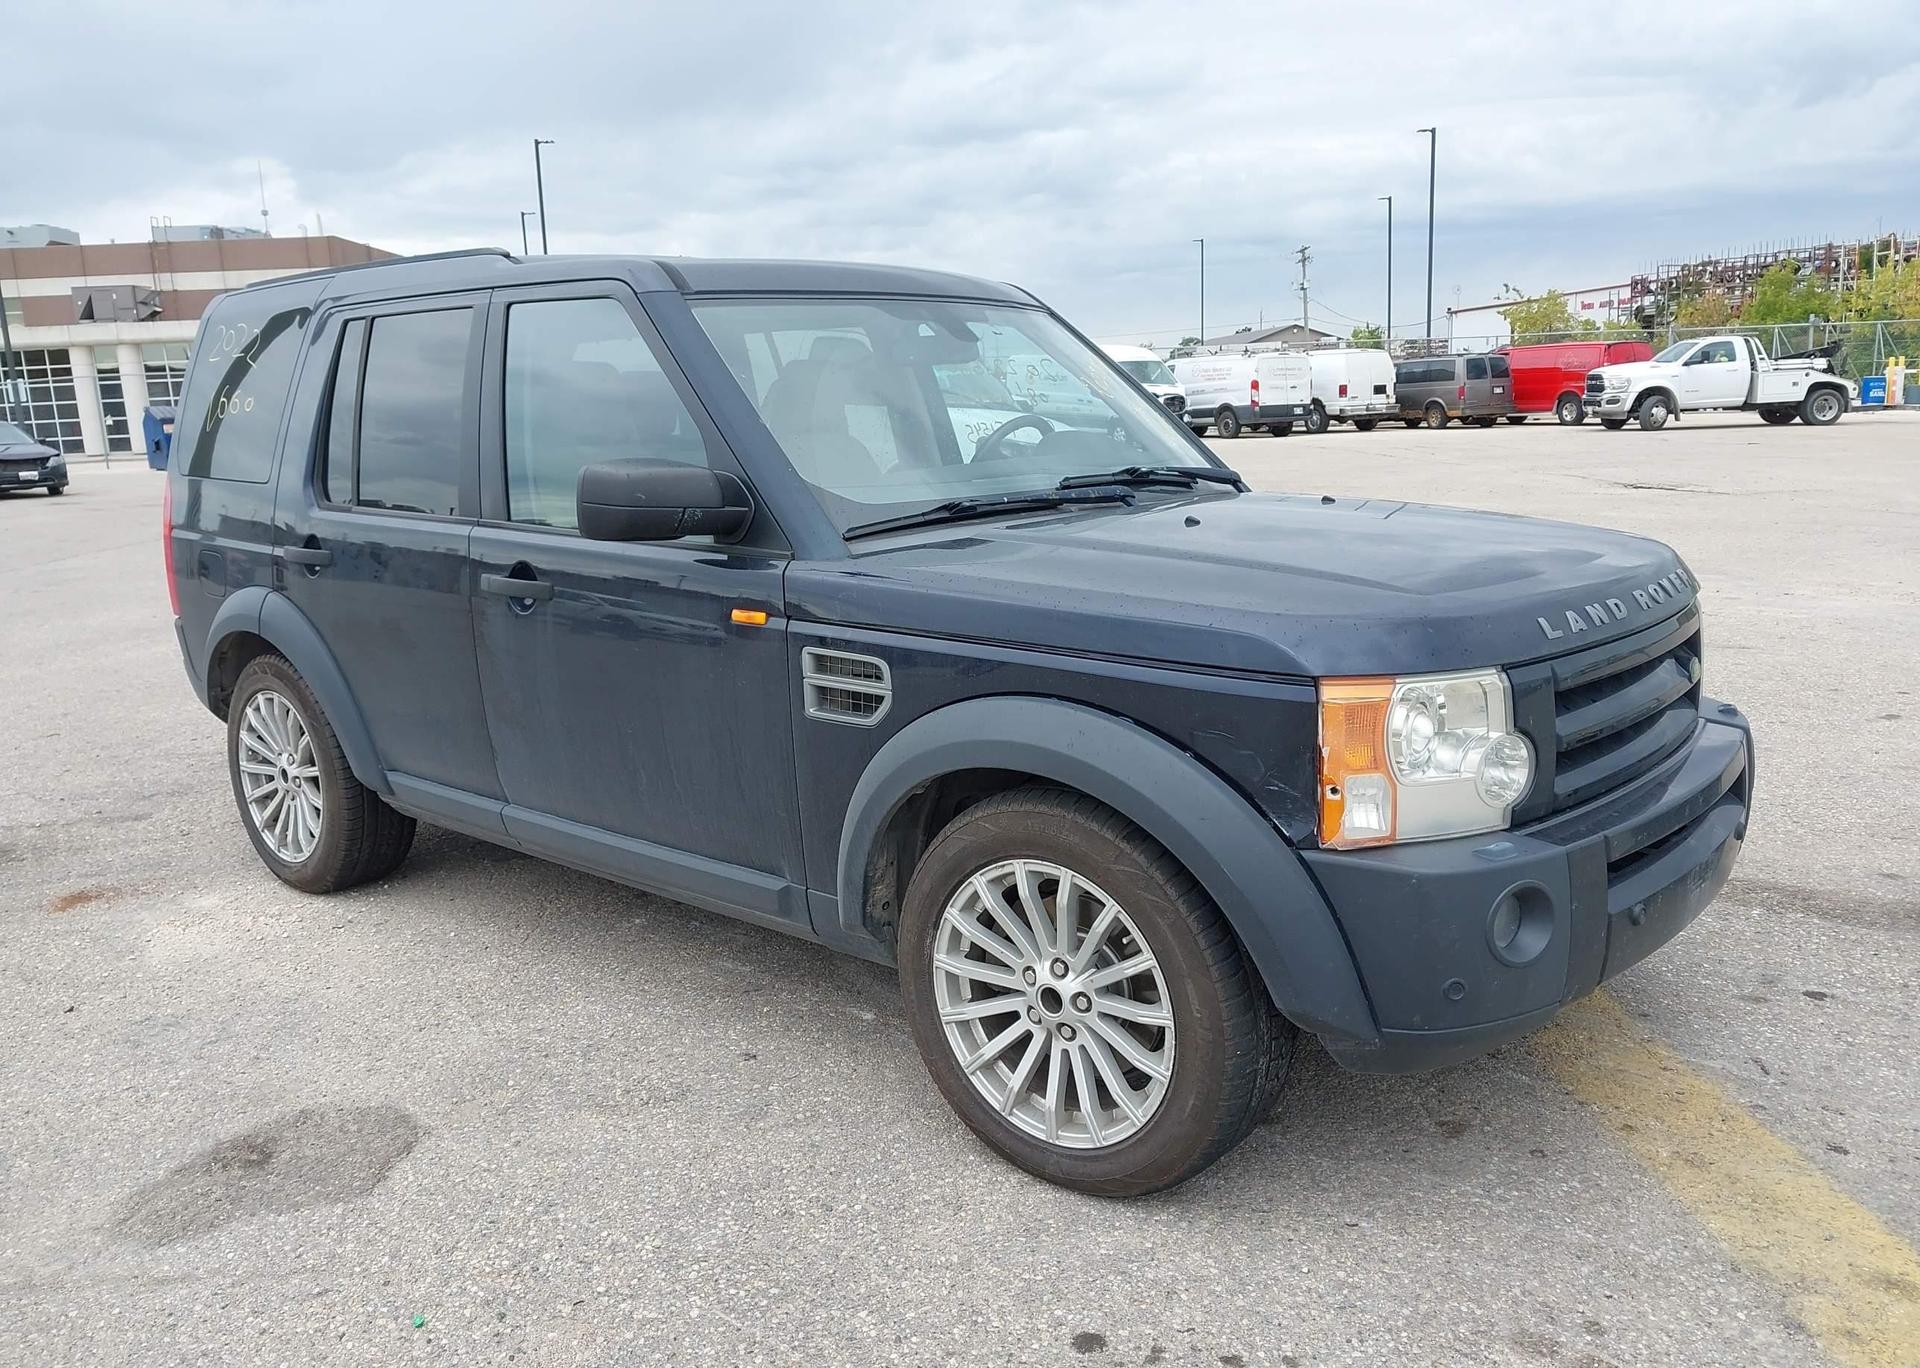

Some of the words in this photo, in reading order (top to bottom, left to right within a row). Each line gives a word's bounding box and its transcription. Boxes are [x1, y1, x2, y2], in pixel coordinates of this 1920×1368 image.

[208, 323, 261, 369] 2022
[1536, 598, 1629, 640] LAND
[1631, 567, 1693, 611] ROVER
